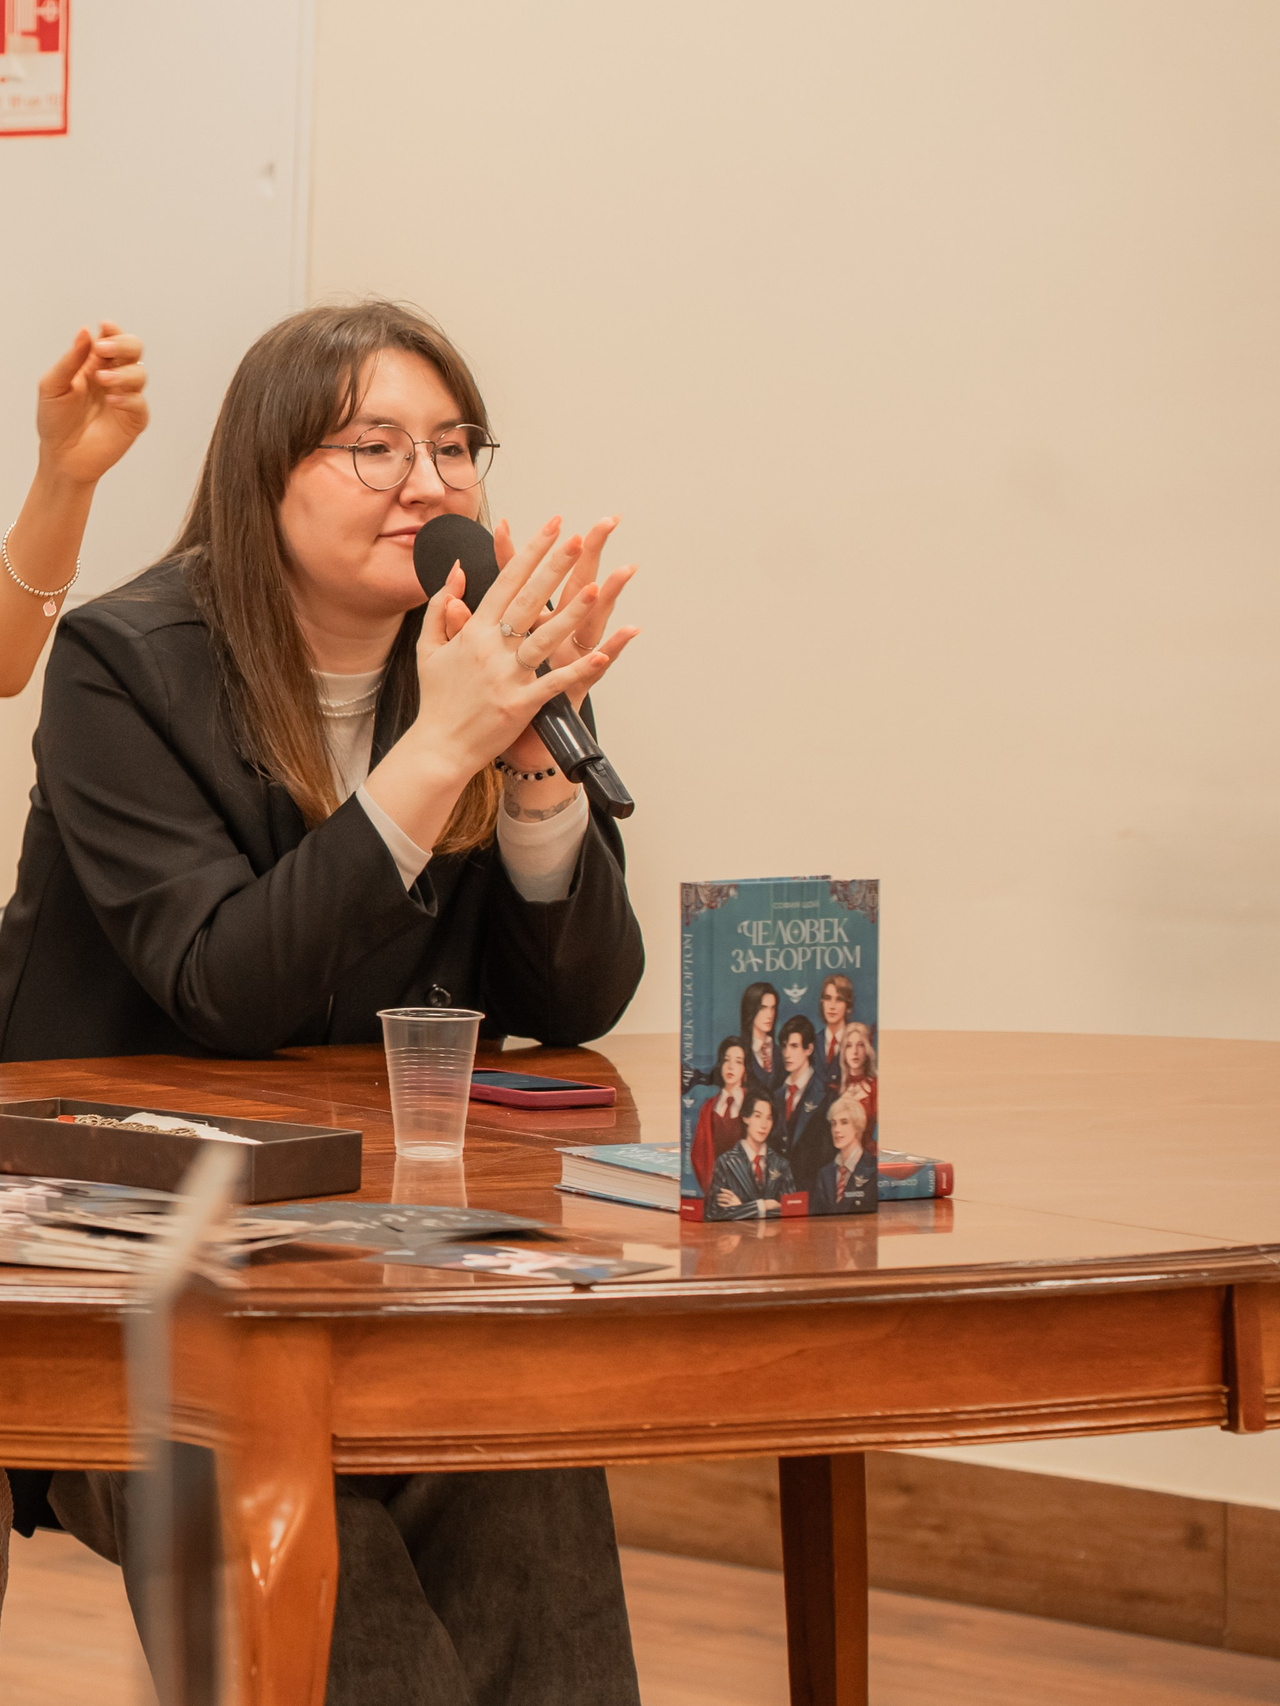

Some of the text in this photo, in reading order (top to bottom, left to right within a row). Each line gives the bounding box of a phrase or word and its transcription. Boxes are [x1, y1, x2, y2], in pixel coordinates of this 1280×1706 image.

[737, 918, 849, 945] ЧЕЛОВЕК
[730, 945, 861, 973] ЗА БОРТОМ
